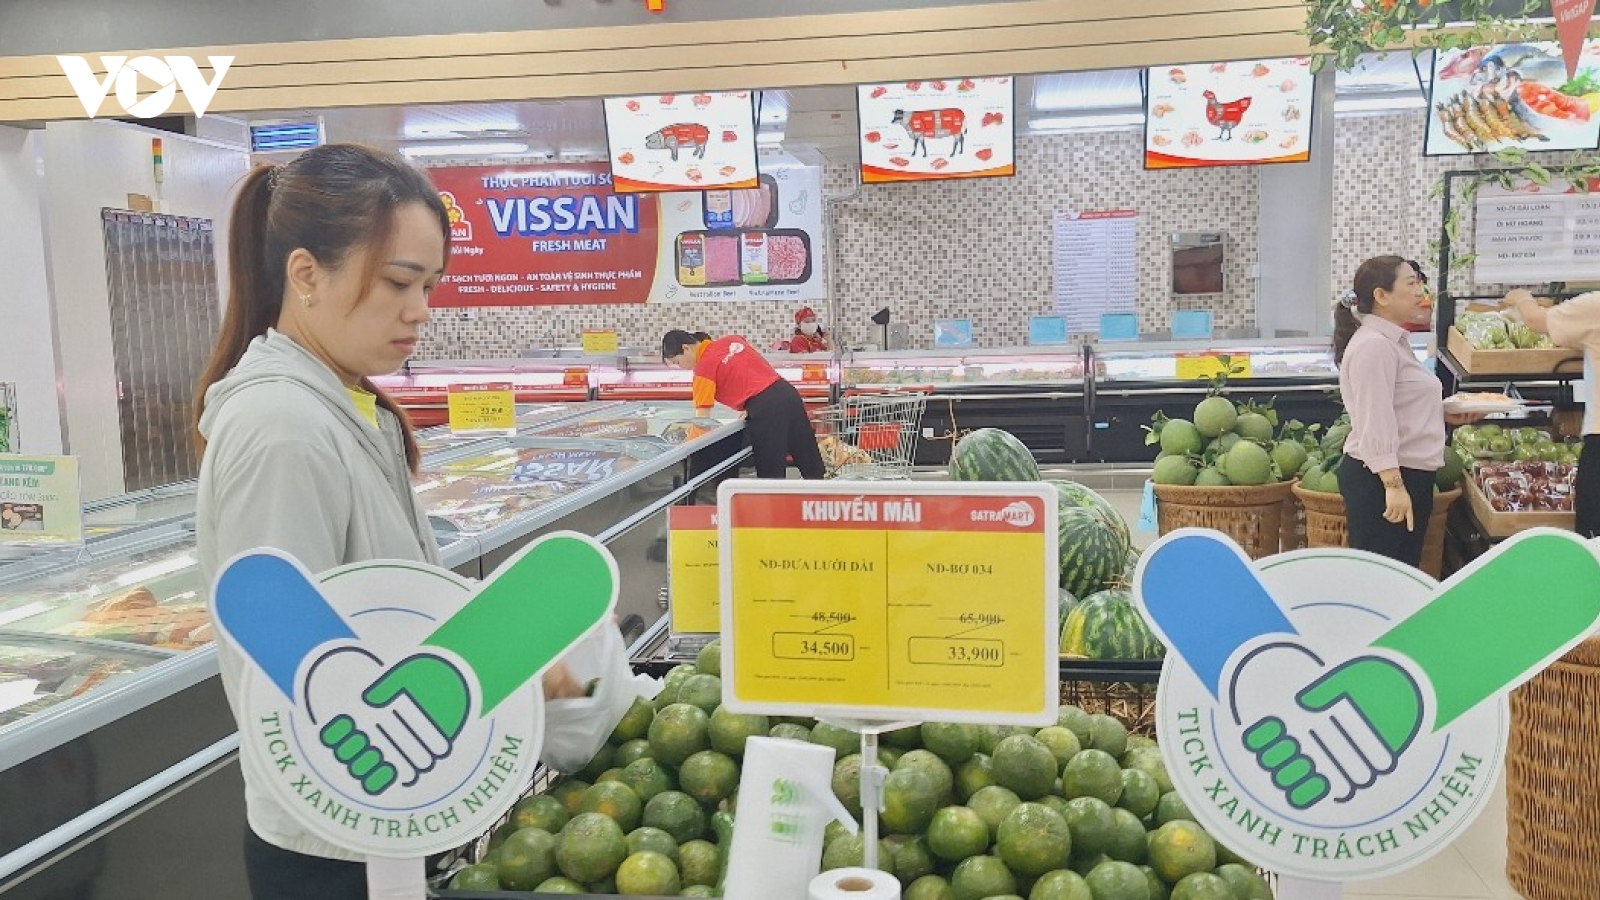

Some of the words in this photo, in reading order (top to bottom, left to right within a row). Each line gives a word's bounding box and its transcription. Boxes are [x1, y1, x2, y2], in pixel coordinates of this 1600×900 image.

[486, 195, 636, 235] VISSAN
[532, 239, 571, 252] FRESH
[574, 239, 607, 251] MEAT
[458, 285, 485, 293] FRESH
[490, 284, 533, 293] DELICIOUS
[540, 284, 571, 292] SAFETY
[581, 283, 617, 291] HYGIENE
[801, 497, 878, 522] KHUYẾN
[882, 498, 922, 523] MÃI
[970, 508, 1031, 523] SATRAMART
[972, 564, 993, 575] 034
[800, 640, 849, 656] 34,500
[948, 646, 998, 662] 33,900
[261, 712, 297, 774] TICK
[291, 774, 362, 831] XANH
[370, 806, 461, 838] TRÁCH
[462, 733, 524, 815] NHIỆM
[1177, 707, 1214, 778] TICK
[1203, 778, 1284, 847] XANH
[1291, 828, 1400, 860] TRÁCH
[1403, 751, 1482, 840] NHIỆM
